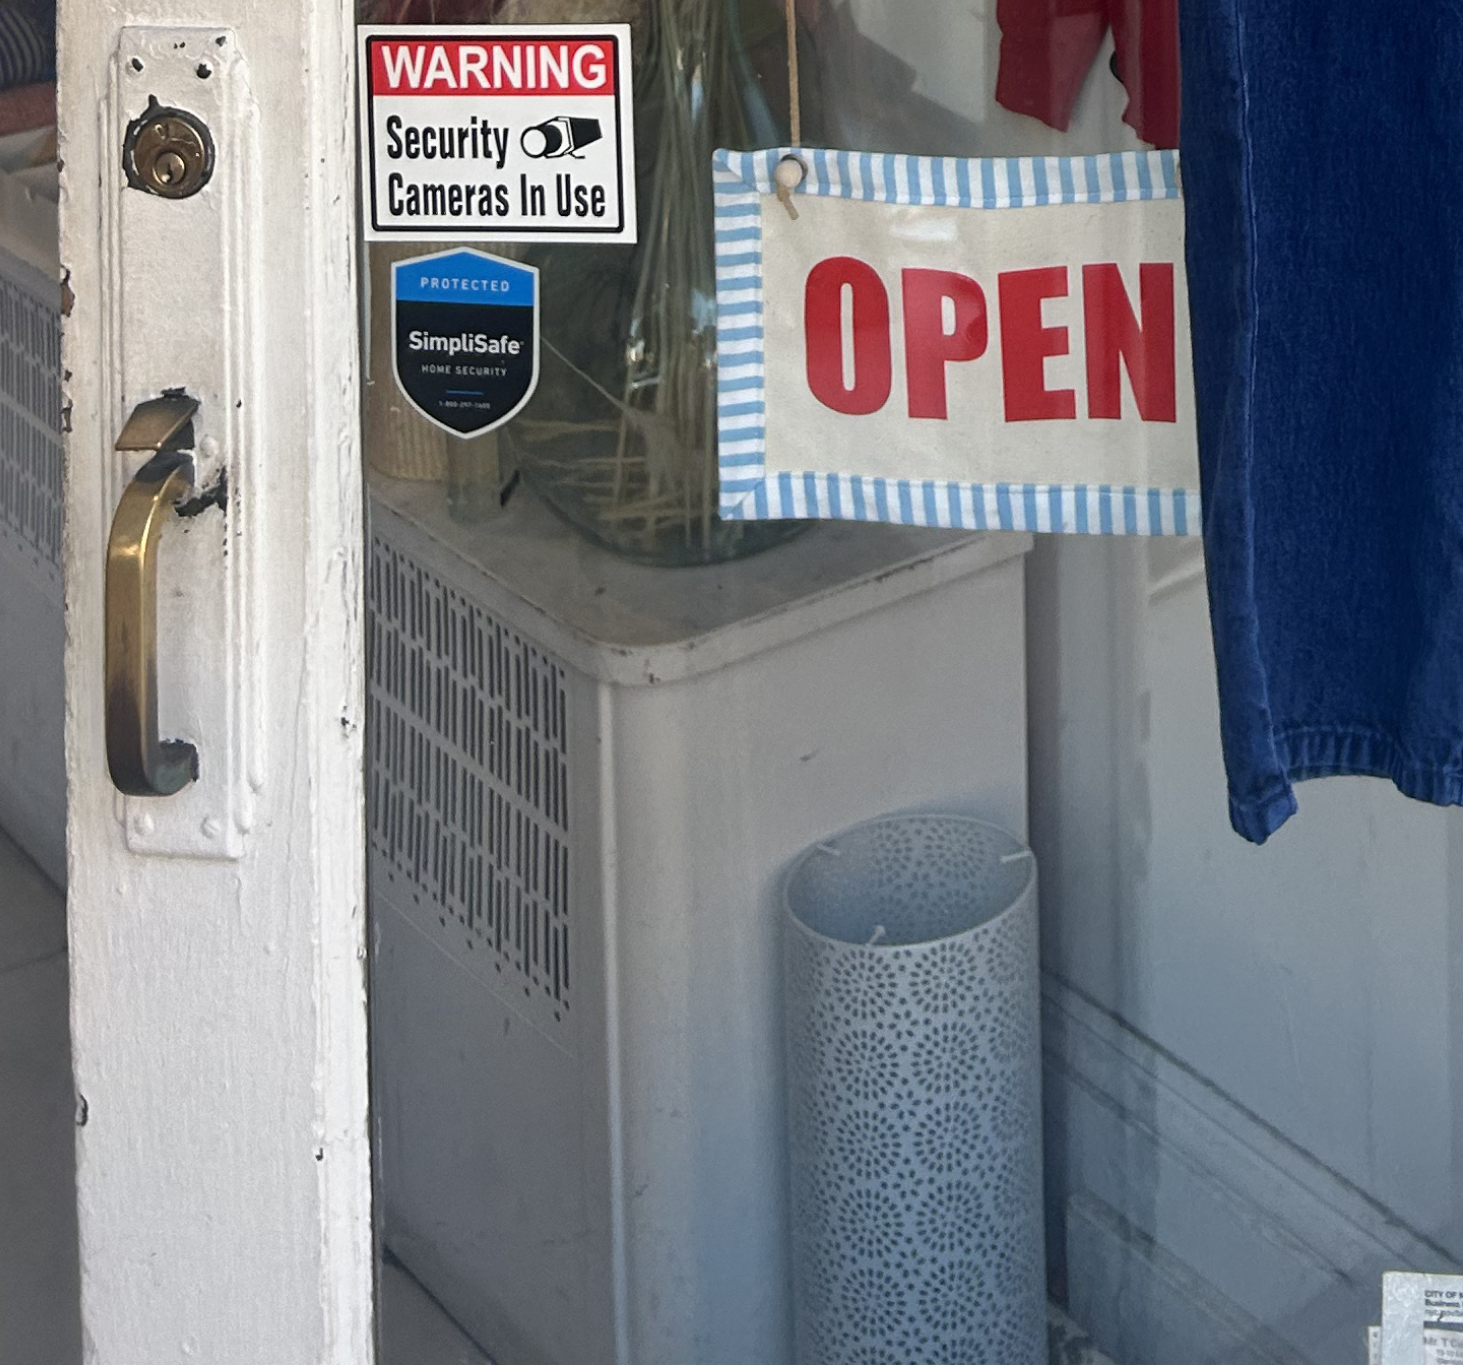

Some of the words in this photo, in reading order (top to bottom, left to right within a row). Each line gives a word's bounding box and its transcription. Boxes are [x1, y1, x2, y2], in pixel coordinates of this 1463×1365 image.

[381, 44, 607, 89] WARNING
[386, 114, 509, 169] Security
[388, 172, 509, 217] Cameras
[520, 173, 546, 217] In
[556, 173, 606, 217] Use
[419, 276, 511, 293] PROTECTED
[408, 330, 521, 356] SimpliSafe
[804, 256, 1177, 423] OPEN
[421, 363, 452, 375] HOME
[454, 365, 508, 378] SECURITY
[1424, 1290, 1445, 1299] CITY
[1446, 1291, 1457, 1299] OF
[1424, 1299, 1460, 1309] Business
